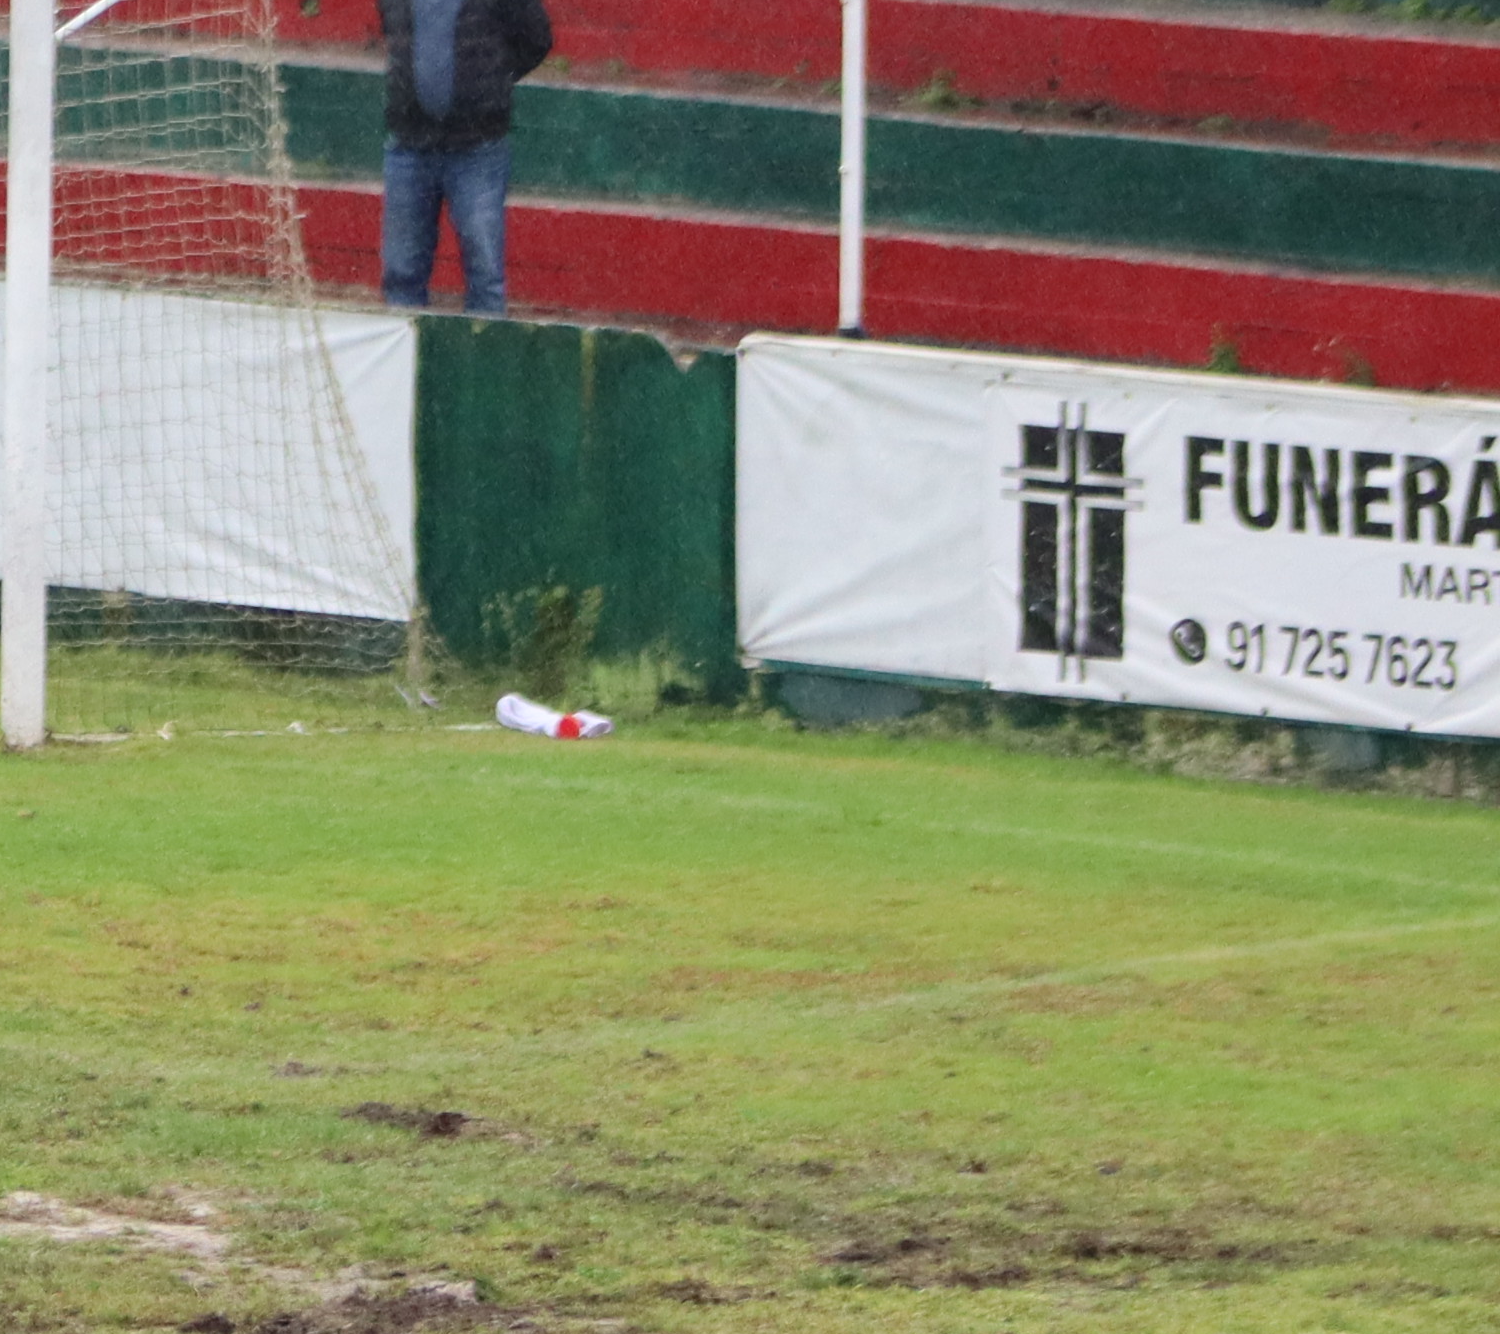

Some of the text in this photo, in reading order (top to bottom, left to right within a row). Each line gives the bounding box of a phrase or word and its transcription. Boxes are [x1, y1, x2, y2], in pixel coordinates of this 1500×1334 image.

[1224, 620, 1459, 692] 91 725 7623
